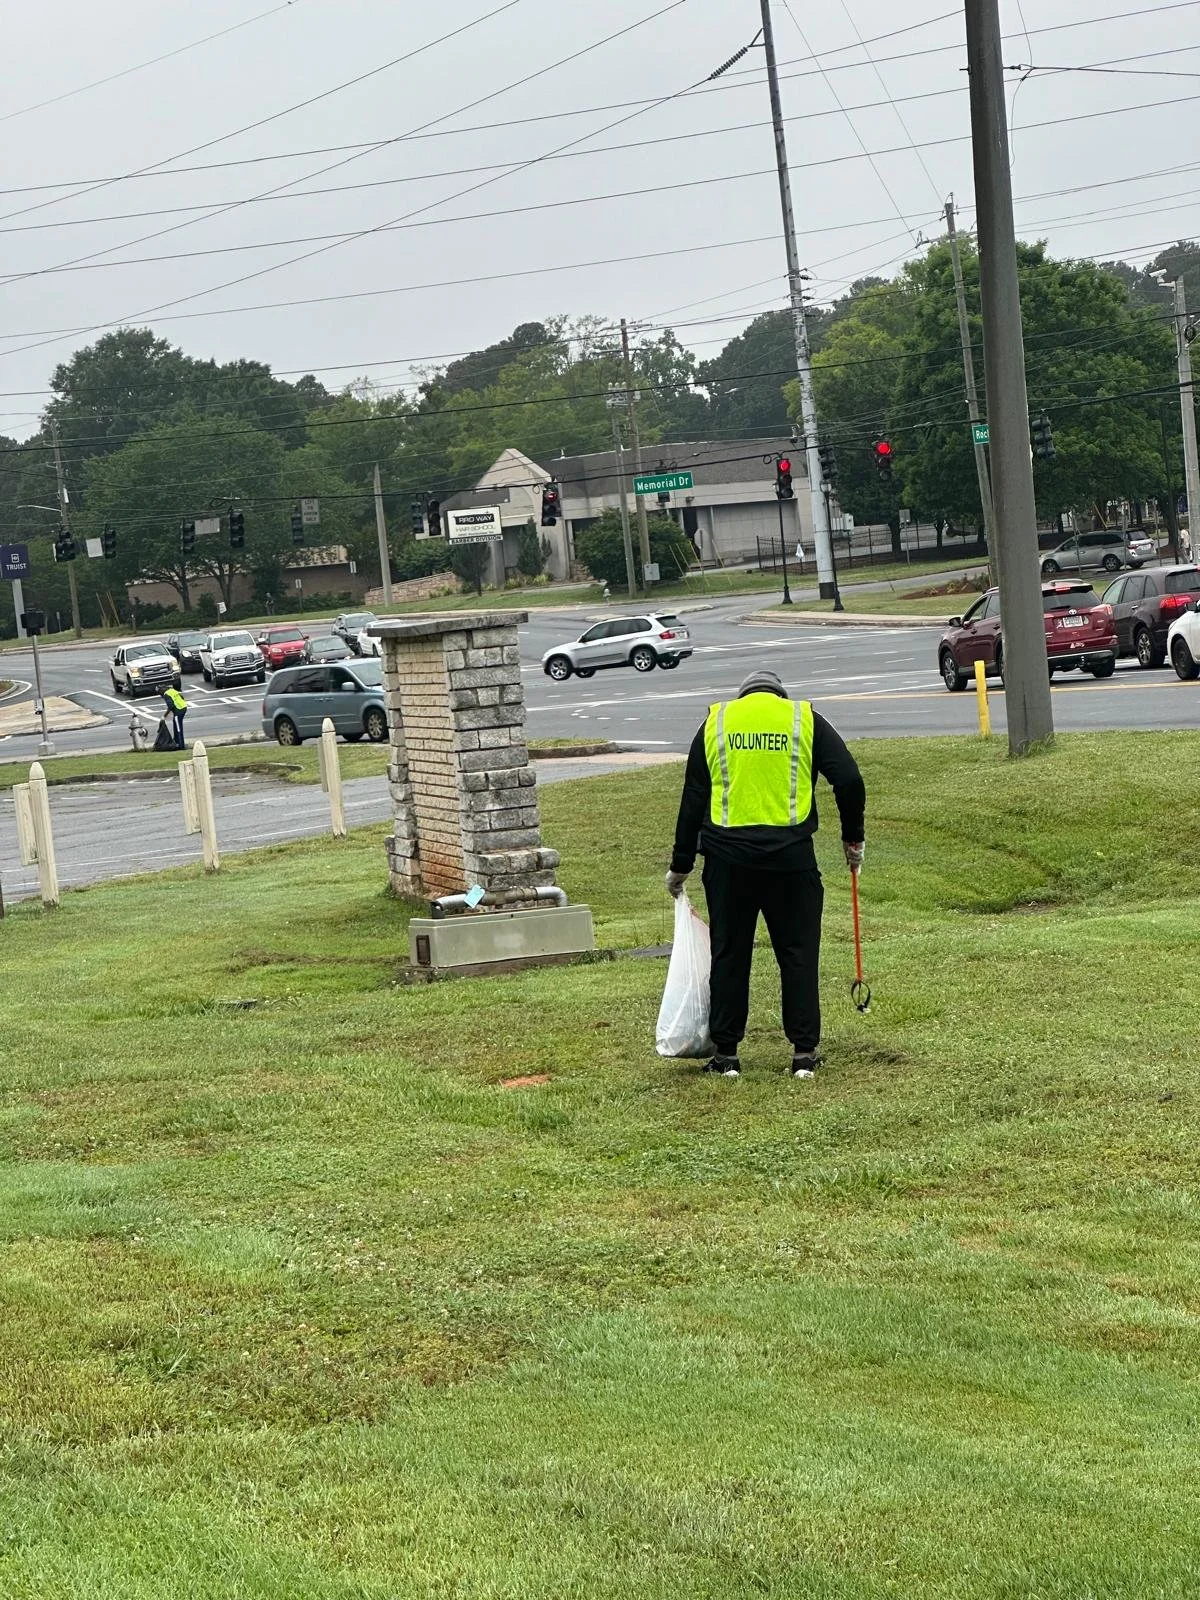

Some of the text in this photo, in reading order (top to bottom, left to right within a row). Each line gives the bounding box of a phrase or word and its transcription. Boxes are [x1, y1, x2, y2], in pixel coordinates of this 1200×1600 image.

[637, 477, 689, 491] Memorial Dr
[475, 514, 492, 522] WAY
[5, 562, 27, 570] TRUIST
[728, 733, 788, 751] VOLUNTEER
